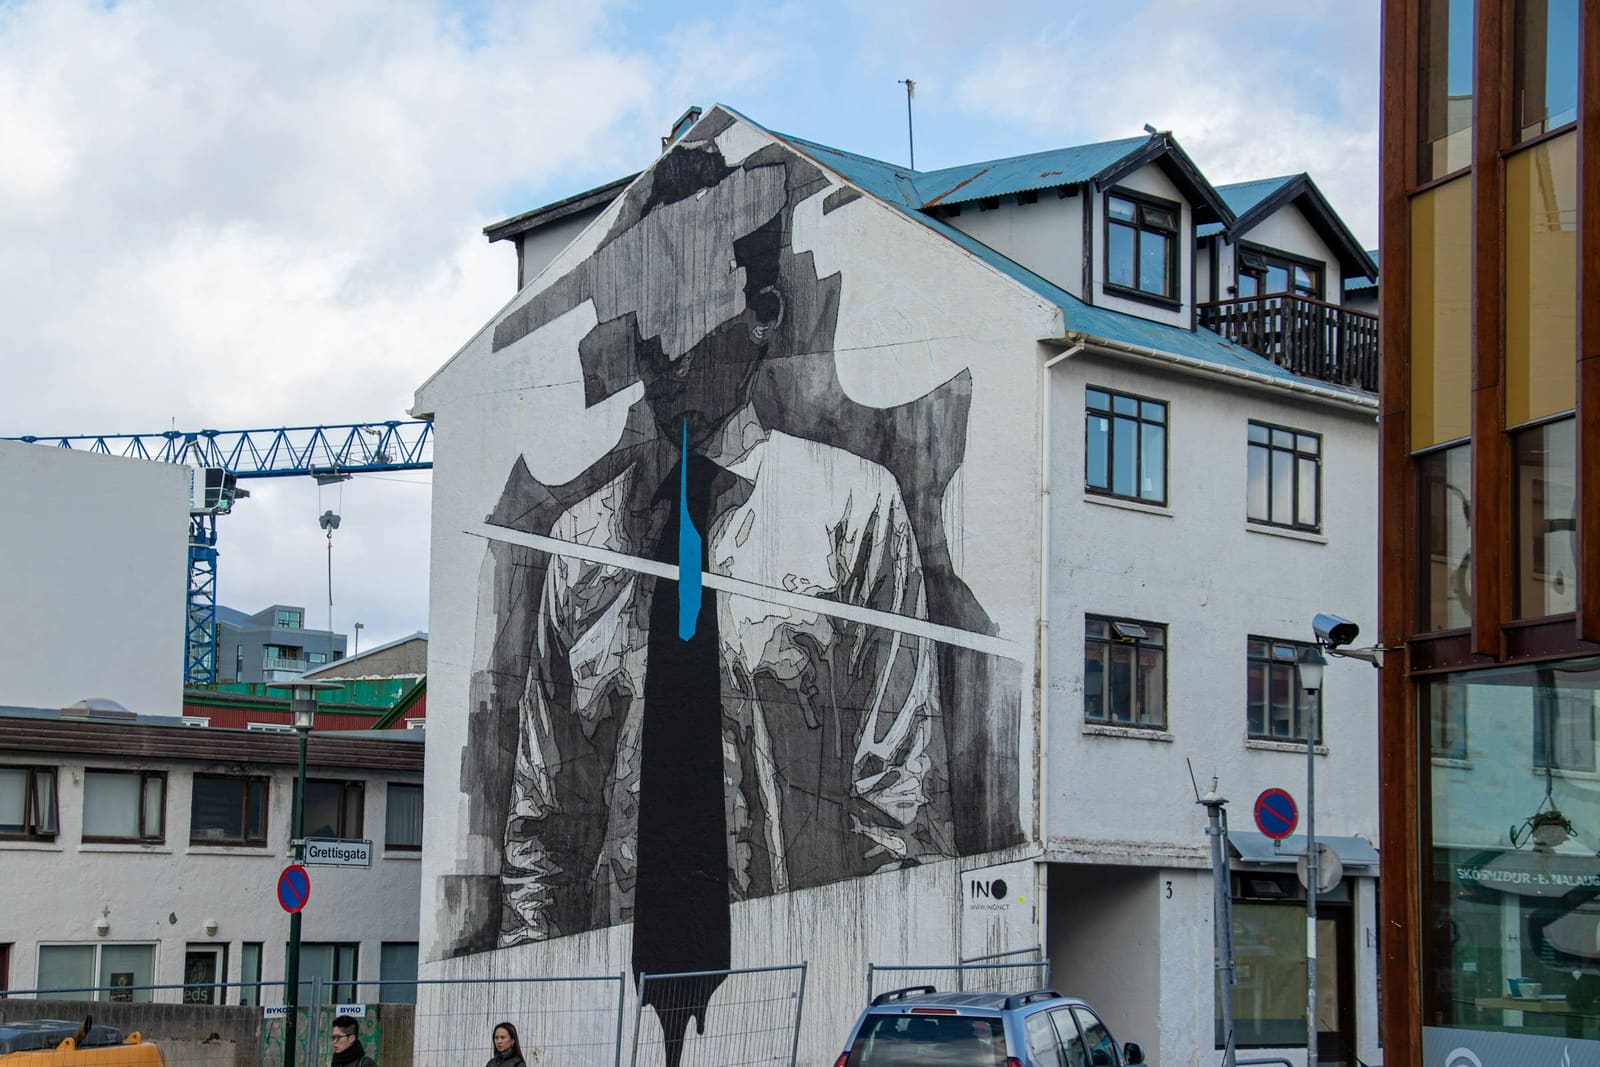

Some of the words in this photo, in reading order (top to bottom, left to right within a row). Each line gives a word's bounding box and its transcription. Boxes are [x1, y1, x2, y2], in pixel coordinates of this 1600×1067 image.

[309, 845, 367, 862] Grettisgata
[971, 879, 1008, 900] INO
[1166, 880, 1173, 900] 3
